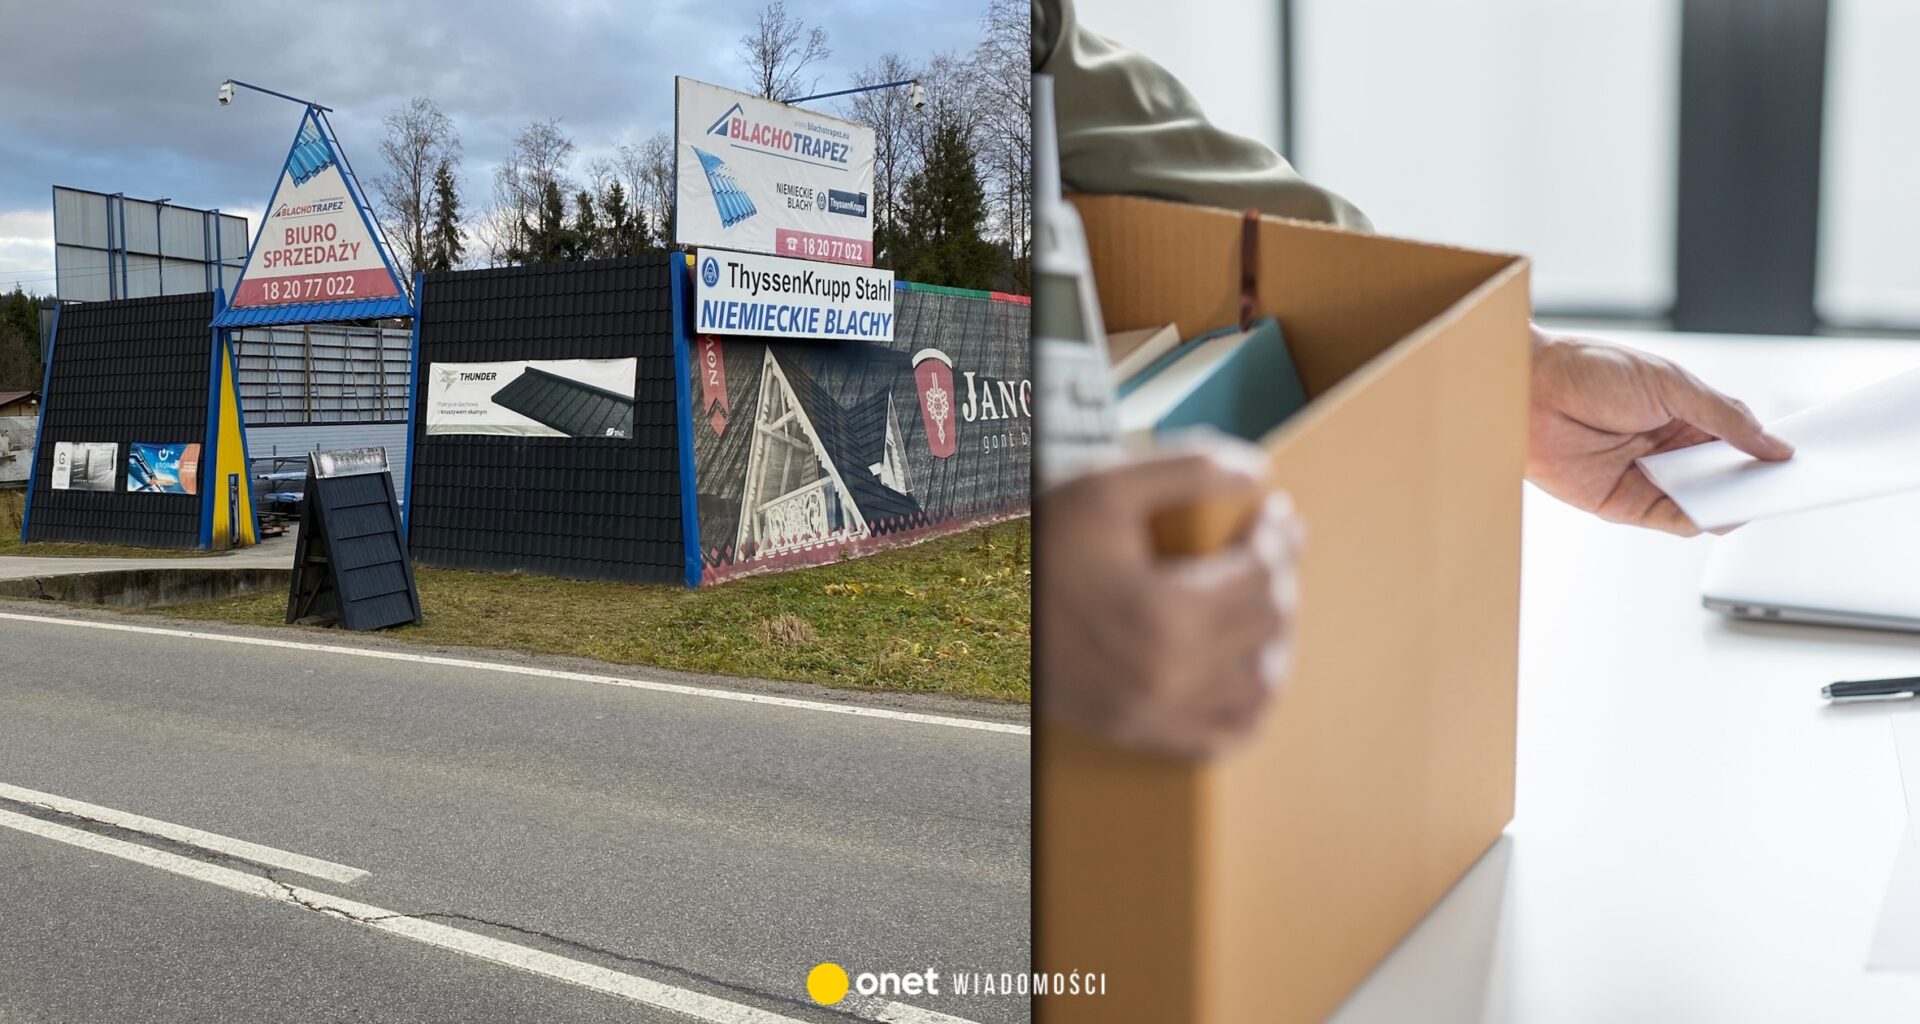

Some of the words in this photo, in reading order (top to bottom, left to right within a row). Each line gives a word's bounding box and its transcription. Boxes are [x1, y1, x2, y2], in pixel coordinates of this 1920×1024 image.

[730, 117, 849, 163] BLACHOTRAPEZ
[776, 182, 813, 200] NIEMIECKIE
[281, 201, 344, 217] BLACHOTRAPEZ
[787, 196, 813, 211] BLACHY
[830, 197, 865, 214] ThyssenKrupp
[285, 223, 337, 246] BIURO
[263, 239, 361, 269] SPRZEDAŻY
[803, 237, 815, 255] 18
[817, 239, 830, 257] 20
[831, 241, 843, 258] 77
[845, 243, 863, 260] 022
[262, 282, 279, 300] 18
[283, 280, 301, 299] 20
[304, 278, 323, 297] 77
[326, 275, 355, 296] 022
[727, 262, 850, 303] ThyssenKrupp
[855, 276, 891, 302] Stahl
[700, 299, 820, 333] NIEMIECKIE
[824, 308, 892, 337] BLACHY
[459, 372, 497, 381] THUNDER
[983, 430, 1014, 454] gont
